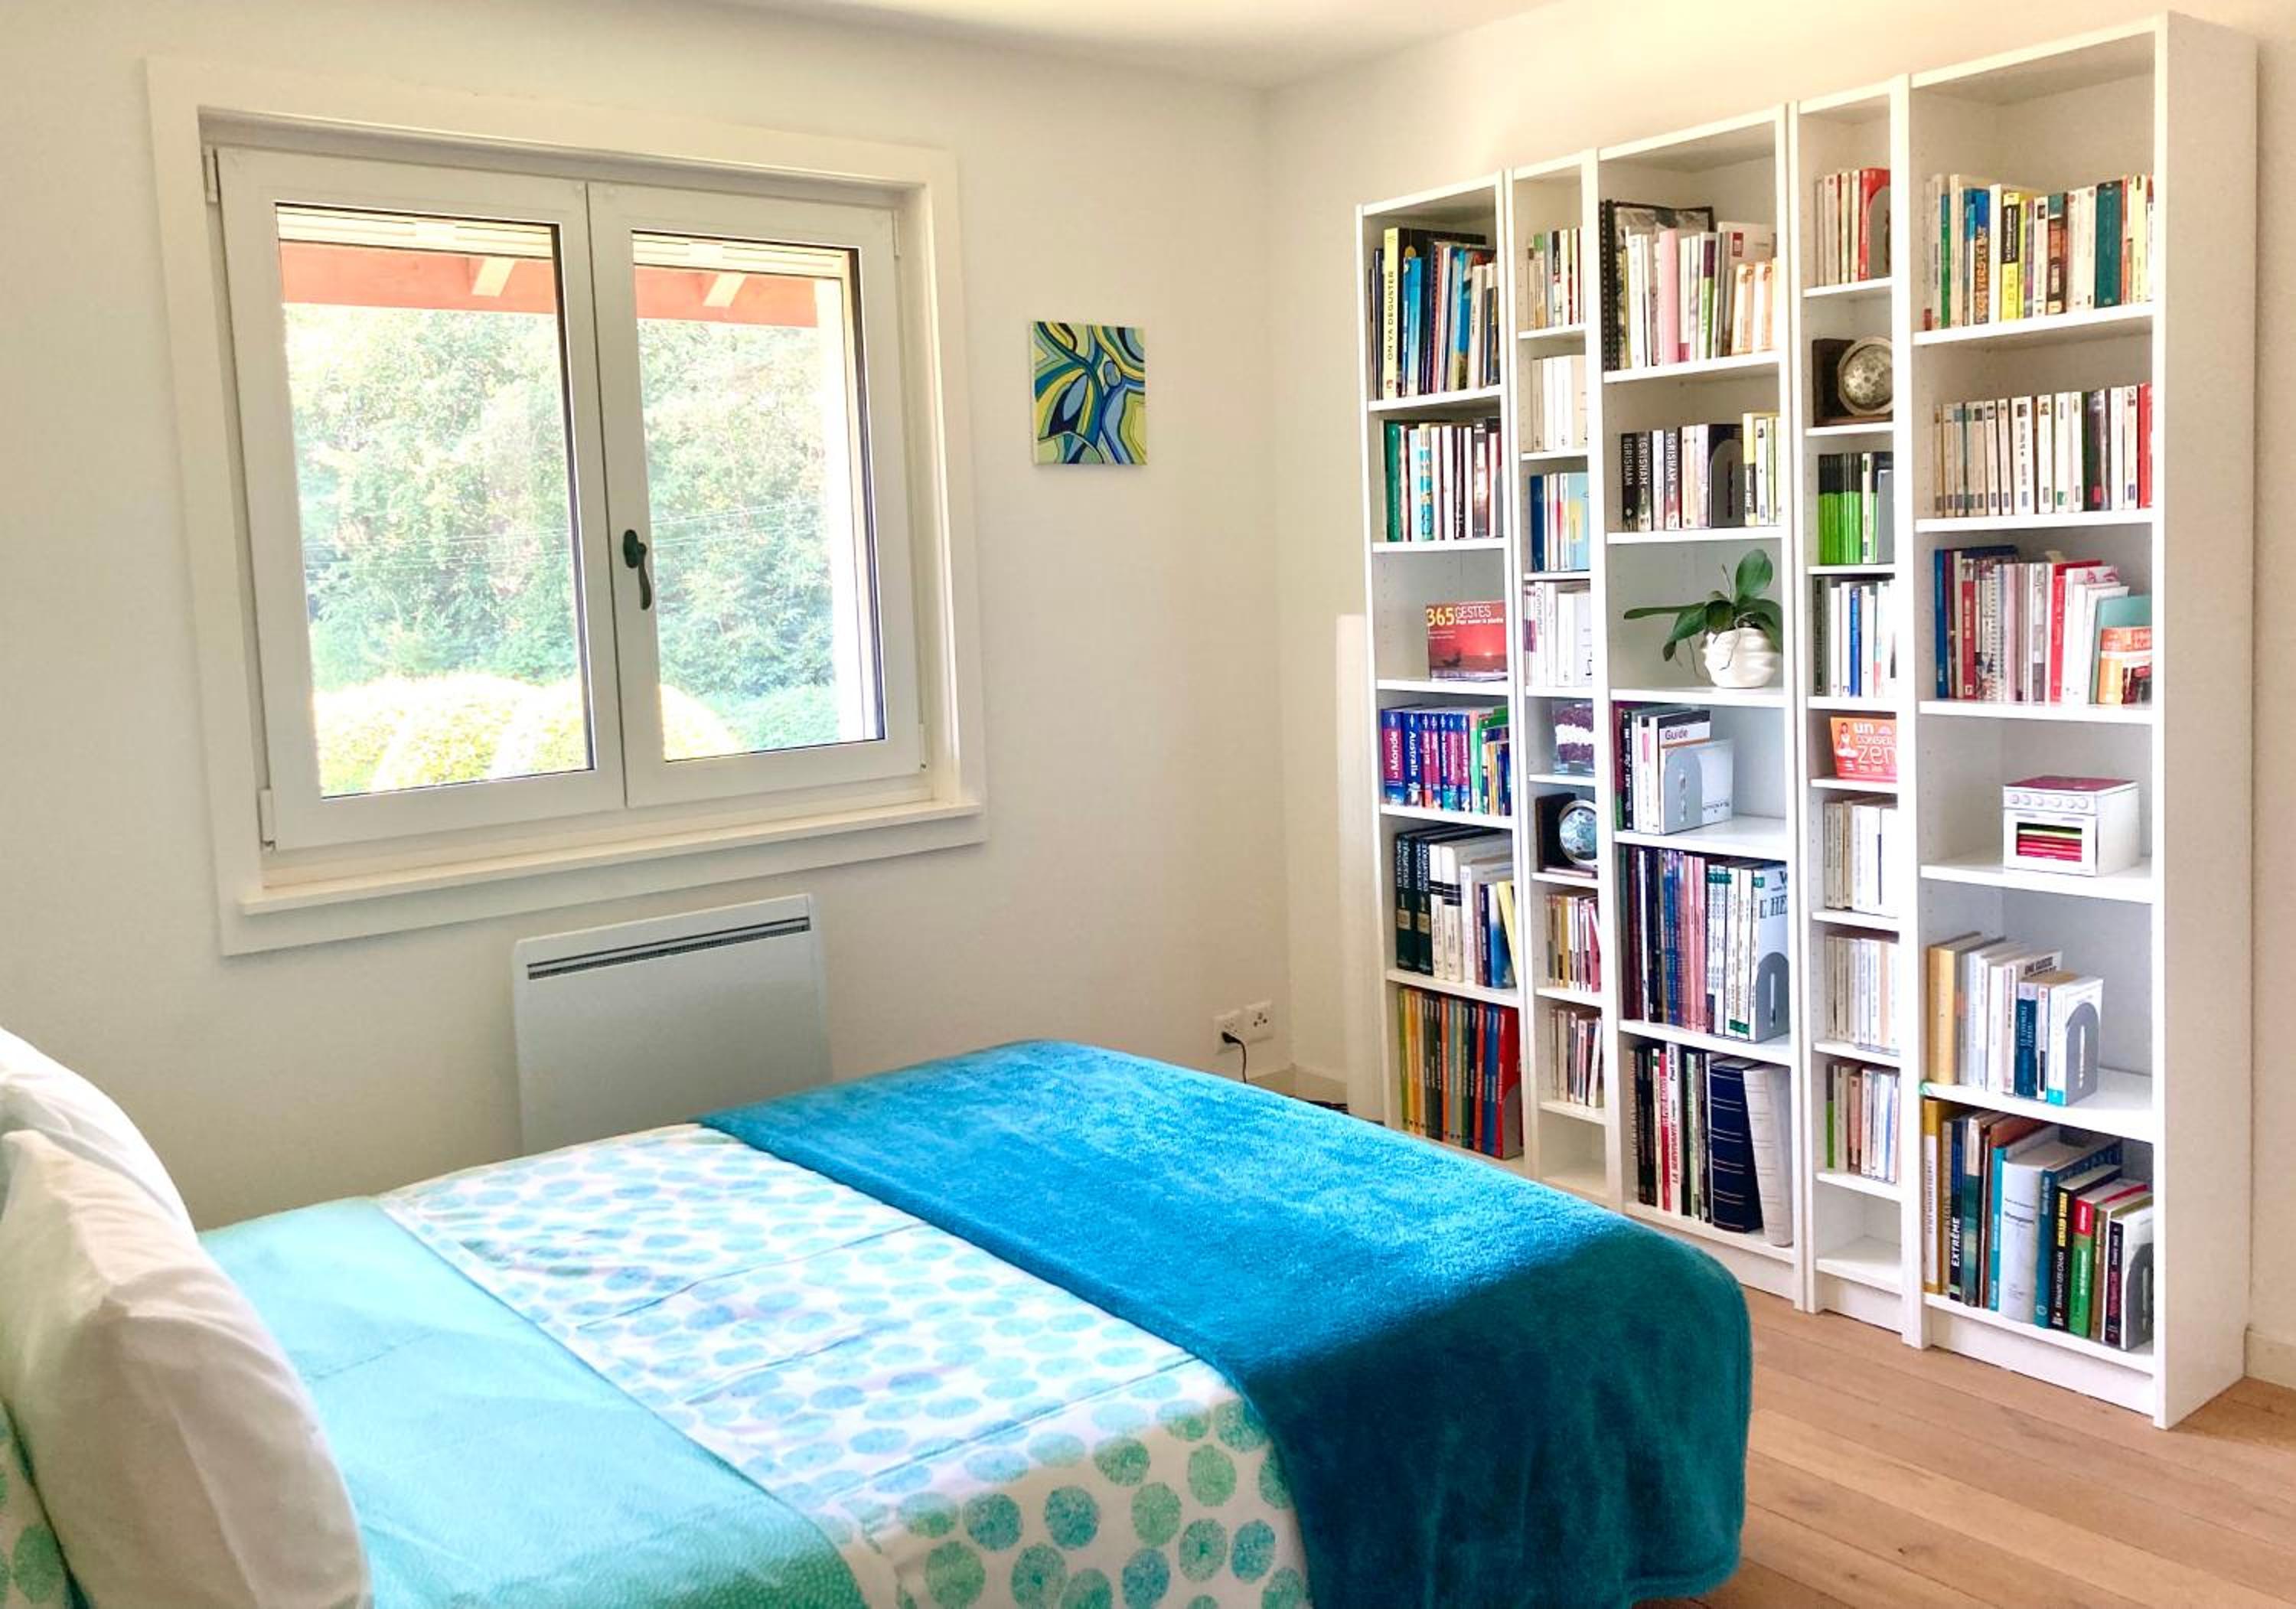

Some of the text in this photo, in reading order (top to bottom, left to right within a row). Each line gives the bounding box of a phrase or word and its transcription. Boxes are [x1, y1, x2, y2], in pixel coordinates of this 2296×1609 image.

[1388, 328, 1394, 343] VA
[1388, 345, 1394, 361] ON
[1623, 443, 1632, 486] GRISHAM
[1639, 443, 1648, 485] GRISHAM
[1667, 439, 1677, 481] GRISHAM
[1426, 605, 1492, 627] 365 GESTES
[1665, 728, 1688, 740] Guide
[1854, 722, 1874, 734] un
[1390, 731, 1399, 771] Monde
[1857, 746, 1896, 764] zen
